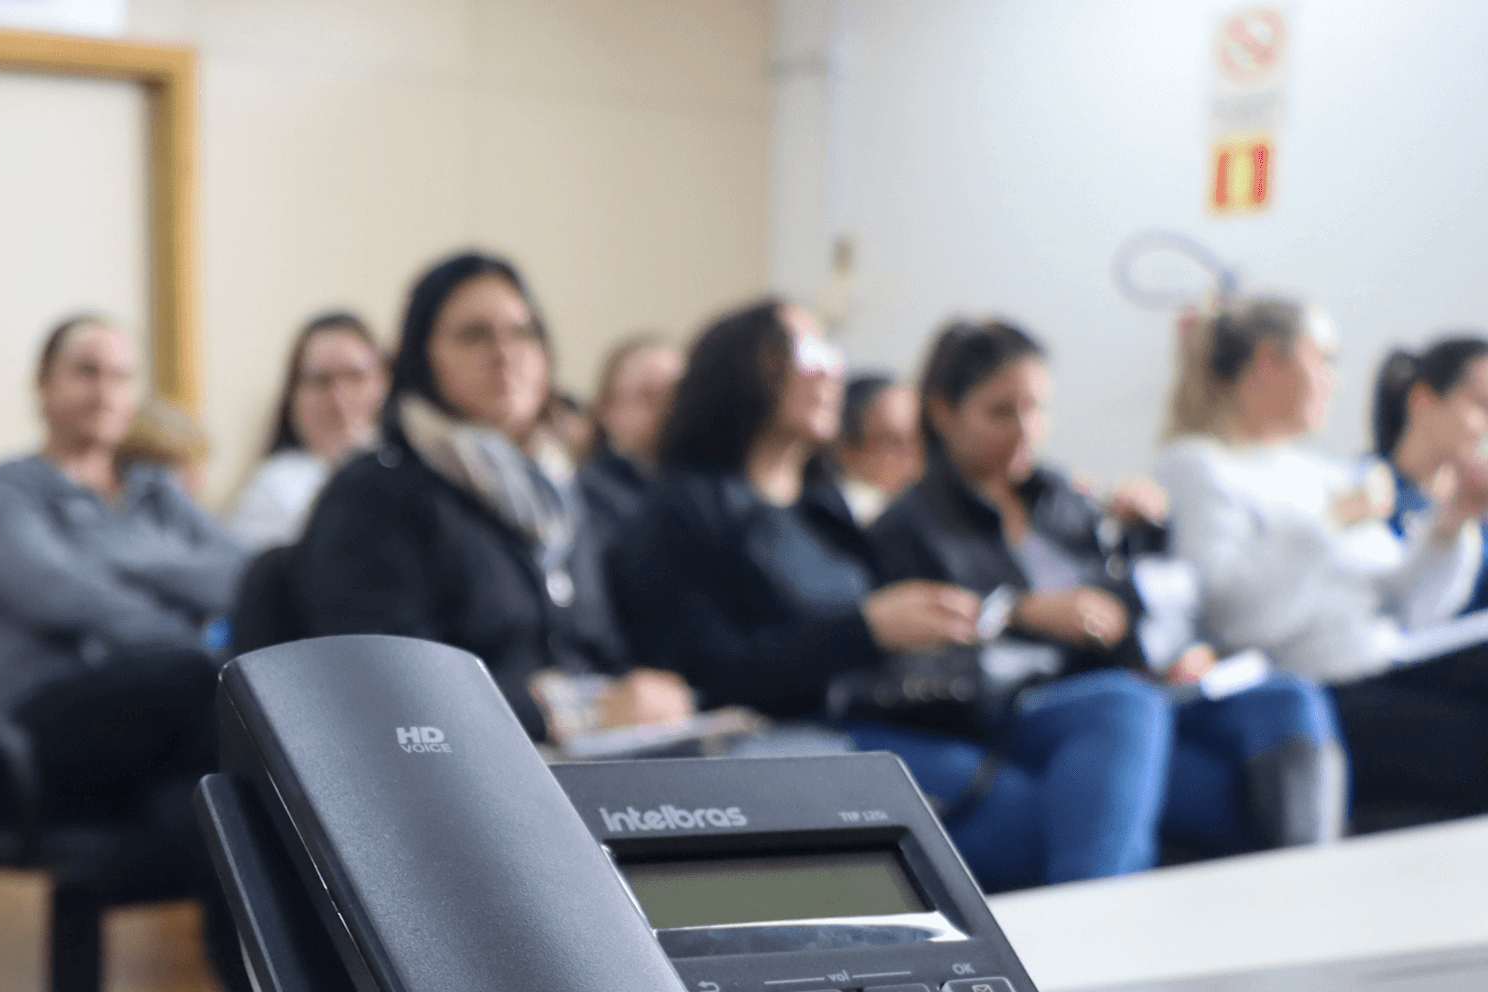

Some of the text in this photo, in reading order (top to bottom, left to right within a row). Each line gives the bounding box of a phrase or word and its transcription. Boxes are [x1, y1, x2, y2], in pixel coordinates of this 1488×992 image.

[395, 726, 445, 745] HD
[400, 742, 454, 755] VOICE
[599, 804, 748, 832] intelbras
[827, 969, 851, 984] vol
[951, 962, 976, 976] OK
